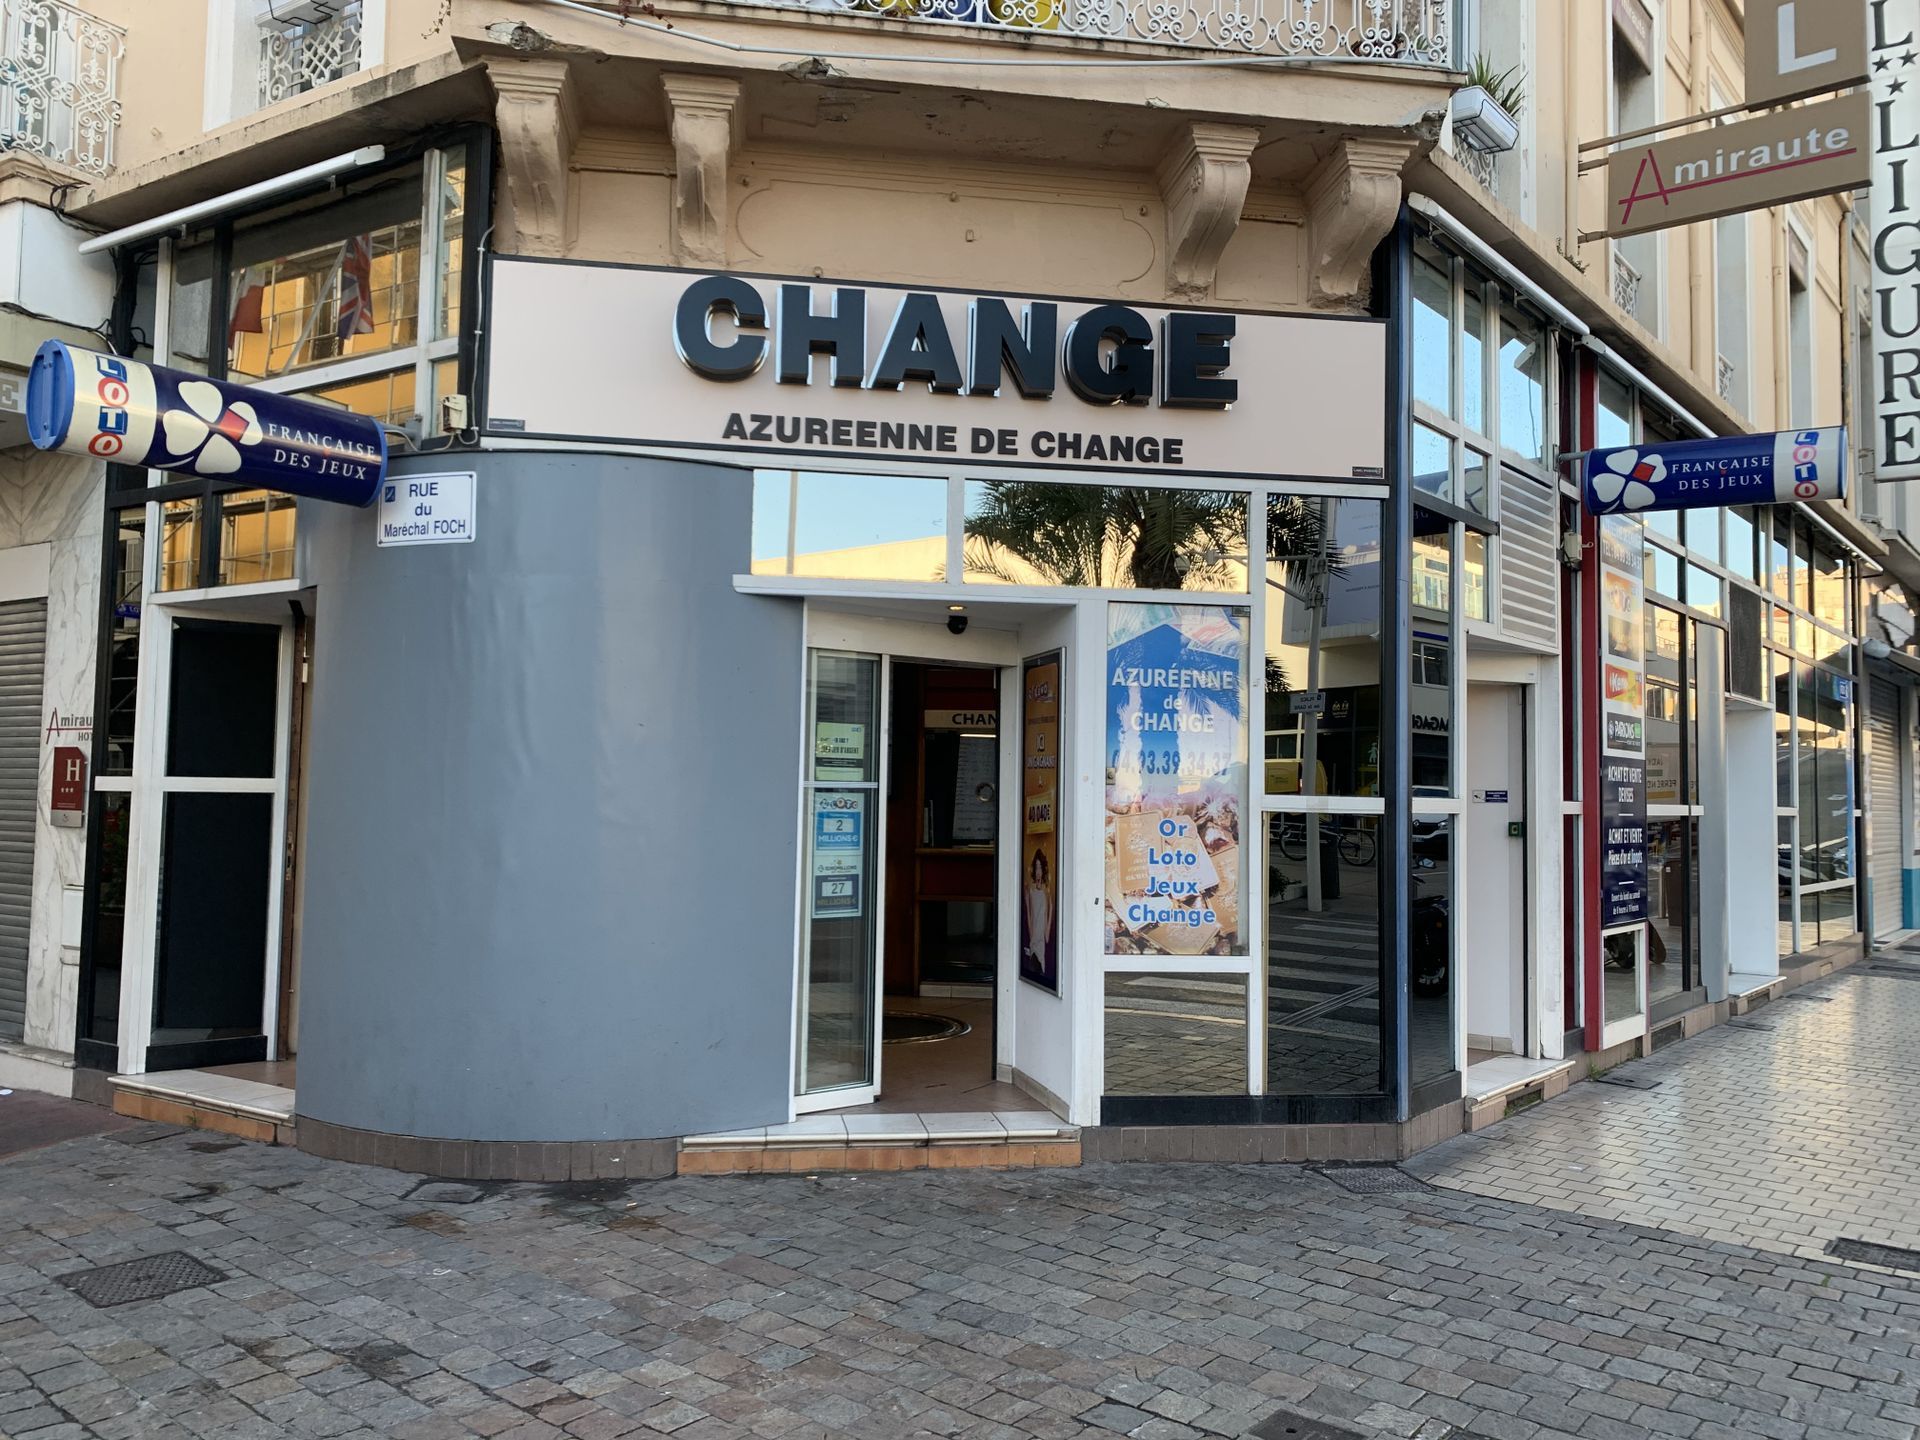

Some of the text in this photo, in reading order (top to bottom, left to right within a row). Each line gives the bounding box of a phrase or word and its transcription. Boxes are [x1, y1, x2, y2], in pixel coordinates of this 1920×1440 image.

[1617, 126, 1851, 225] Amiraute
[673, 276, 1238, 411] CHANGE
[88, 355, 129, 457] LOTO
[722, 412, 1184, 464] AZUREENNE DE CHANGE
[273, 449, 367, 480] DES JEUX
[1792, 431, 1819, 499] LOTO
[408, 482, 439, 498] RUE
[1678, 473, 1763, 491] DES JEUX
[414, 502, 432, 517] du
[384, 519, 466, 538] Maréchal FOCH
[1112, 662, 1234, 690] AZURÉENNE
[1163, 694, 1183, 710] de
[1130, 712, 1215, 733] CHANGE
[66, 758, 81, 782] H
[836, 819, 844, 831] 2
[1158, 819, 1189, 837] Or
[1148, 847, 1197, 866] Loto
[831, 882, 846, 895] 27
[1145, 876, 1198, 895] Jeux
[1127, 904, 1216, 928] Change
